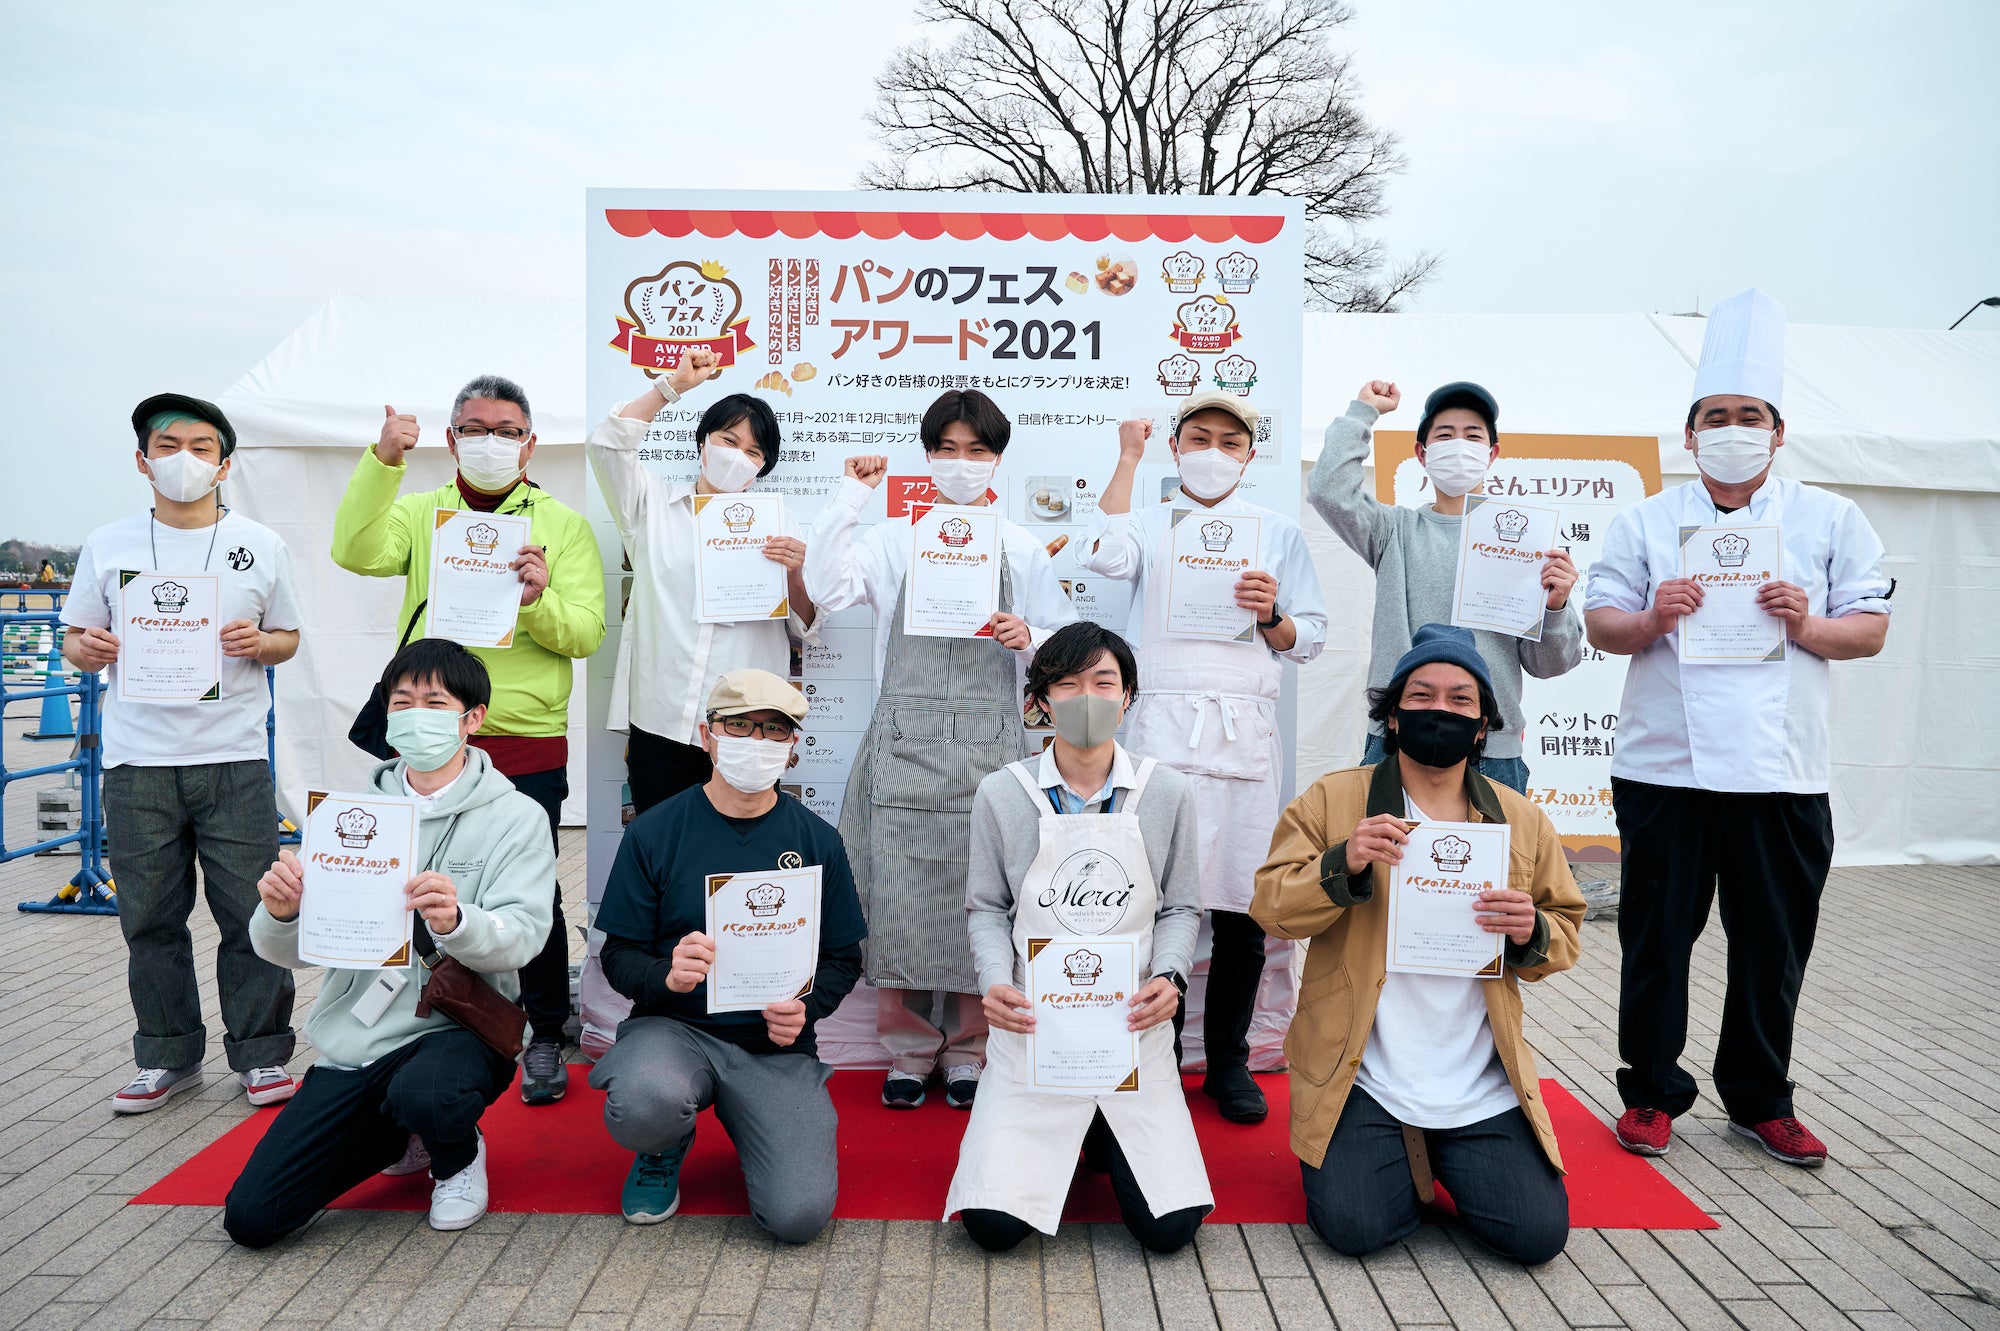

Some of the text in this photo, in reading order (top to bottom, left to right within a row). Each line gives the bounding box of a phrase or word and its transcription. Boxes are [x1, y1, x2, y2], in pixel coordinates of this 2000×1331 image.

[660, 280, 706, 297] パン
[806, 259, 819, 325] パン好きの
[830, 259, 1064, 306] パンのフェス
[661, 306, 705, 322] フェス
[768, 259, 782, 364] パン好きのための
[787, 259, 800, 351] パン好きによる
[669, 325, 698, 337] 2021
[831, 317, 1101, 361] アワード2021
[1018, 413, 1122, 425] 自信作をエントリー。
[1075, 492, 1097, 500] Lycka
[1480, 474, 1614, 499] さんエリア内
[312, 853, 400, 869] パンのフェス2022春
[1038, 879, 1134, 908] Merci
[1041, 991, 1124, 1003] パンのフェス2022春
